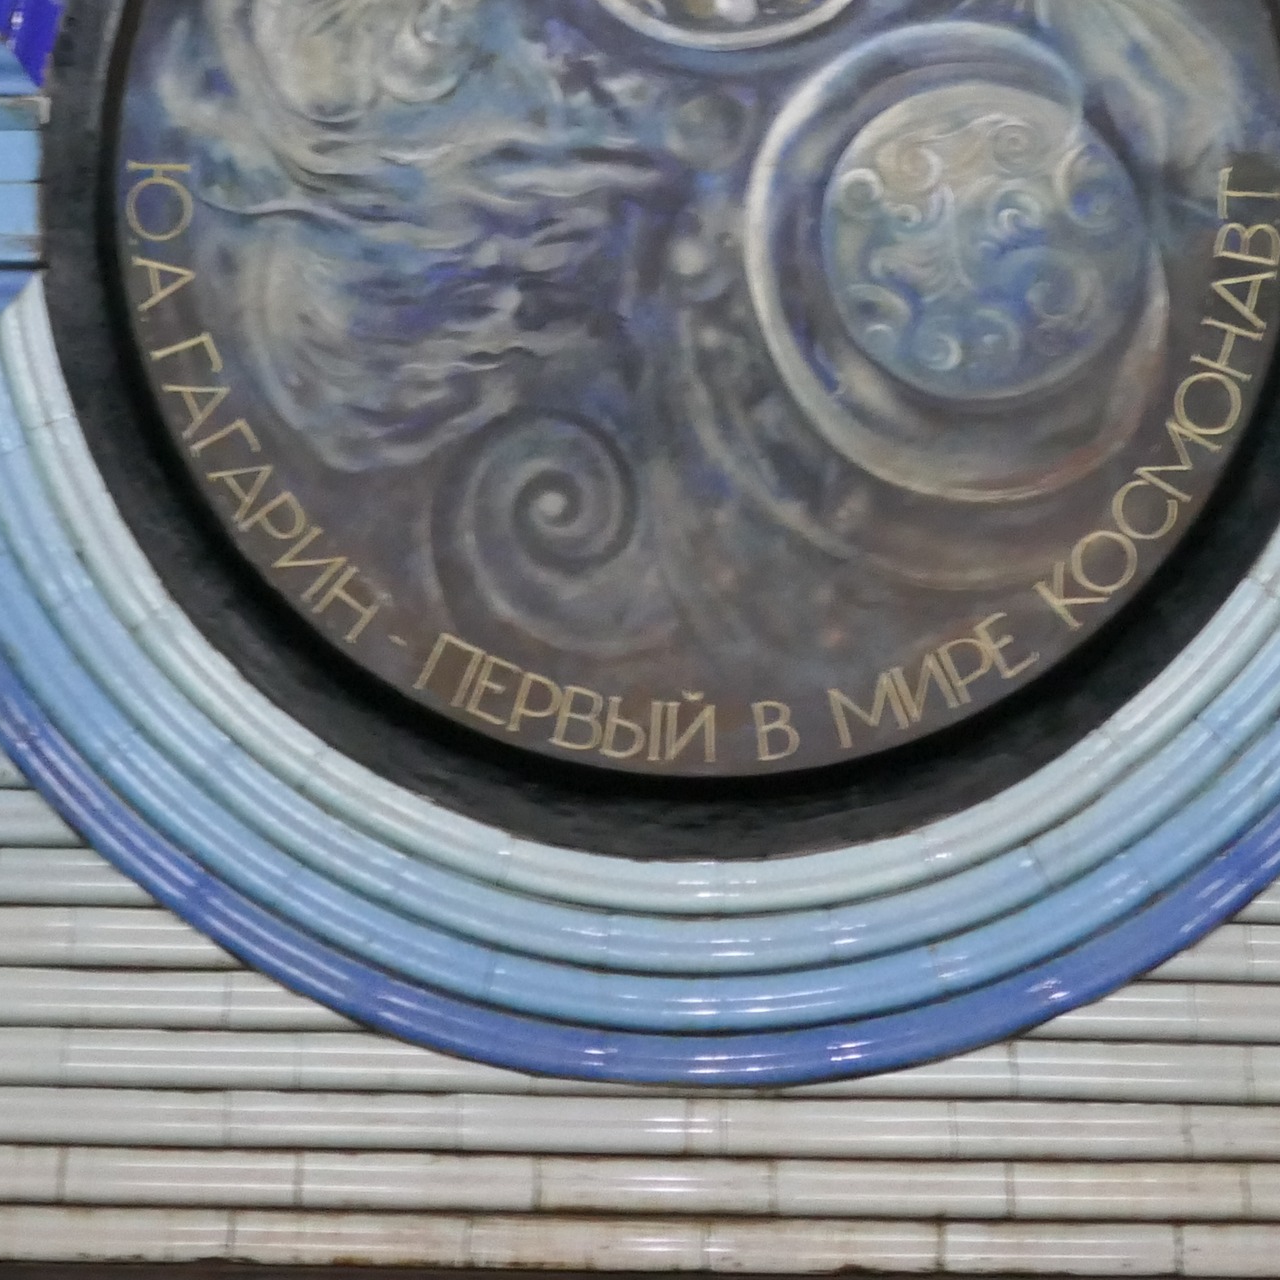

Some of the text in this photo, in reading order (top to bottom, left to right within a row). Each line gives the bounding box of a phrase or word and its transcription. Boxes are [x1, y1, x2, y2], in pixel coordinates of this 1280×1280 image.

[150, 331, 381, 644] ГАГАРИН
[412, 632, 718, 763] ПЕРВЫЙ
[752, 700, 800, 762] В
[827, 611, 1040, 749] МИРЕ
